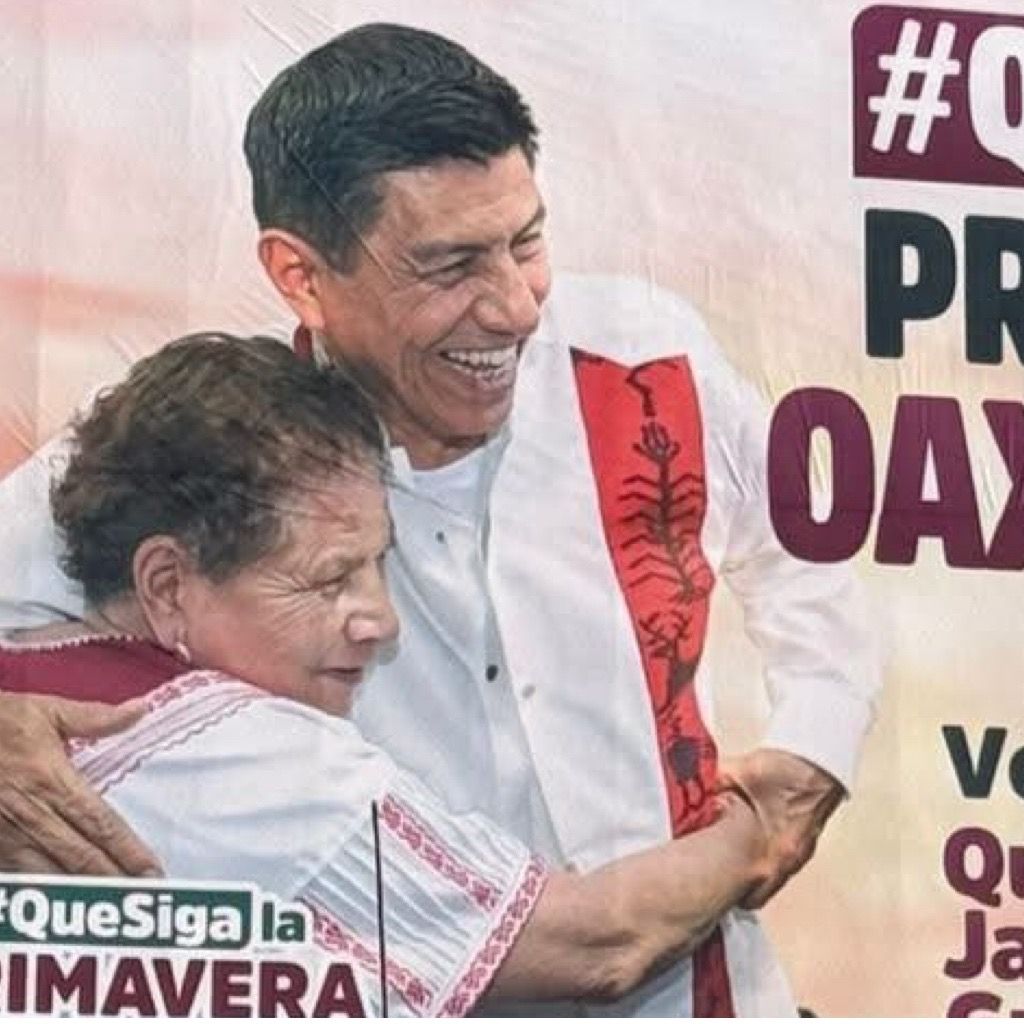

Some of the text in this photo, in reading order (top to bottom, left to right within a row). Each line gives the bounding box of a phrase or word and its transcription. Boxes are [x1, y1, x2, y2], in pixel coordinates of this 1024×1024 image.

[0, 888, 306, 945] QueSiga la
[0, 953, 367, 1018] IMAVERA
